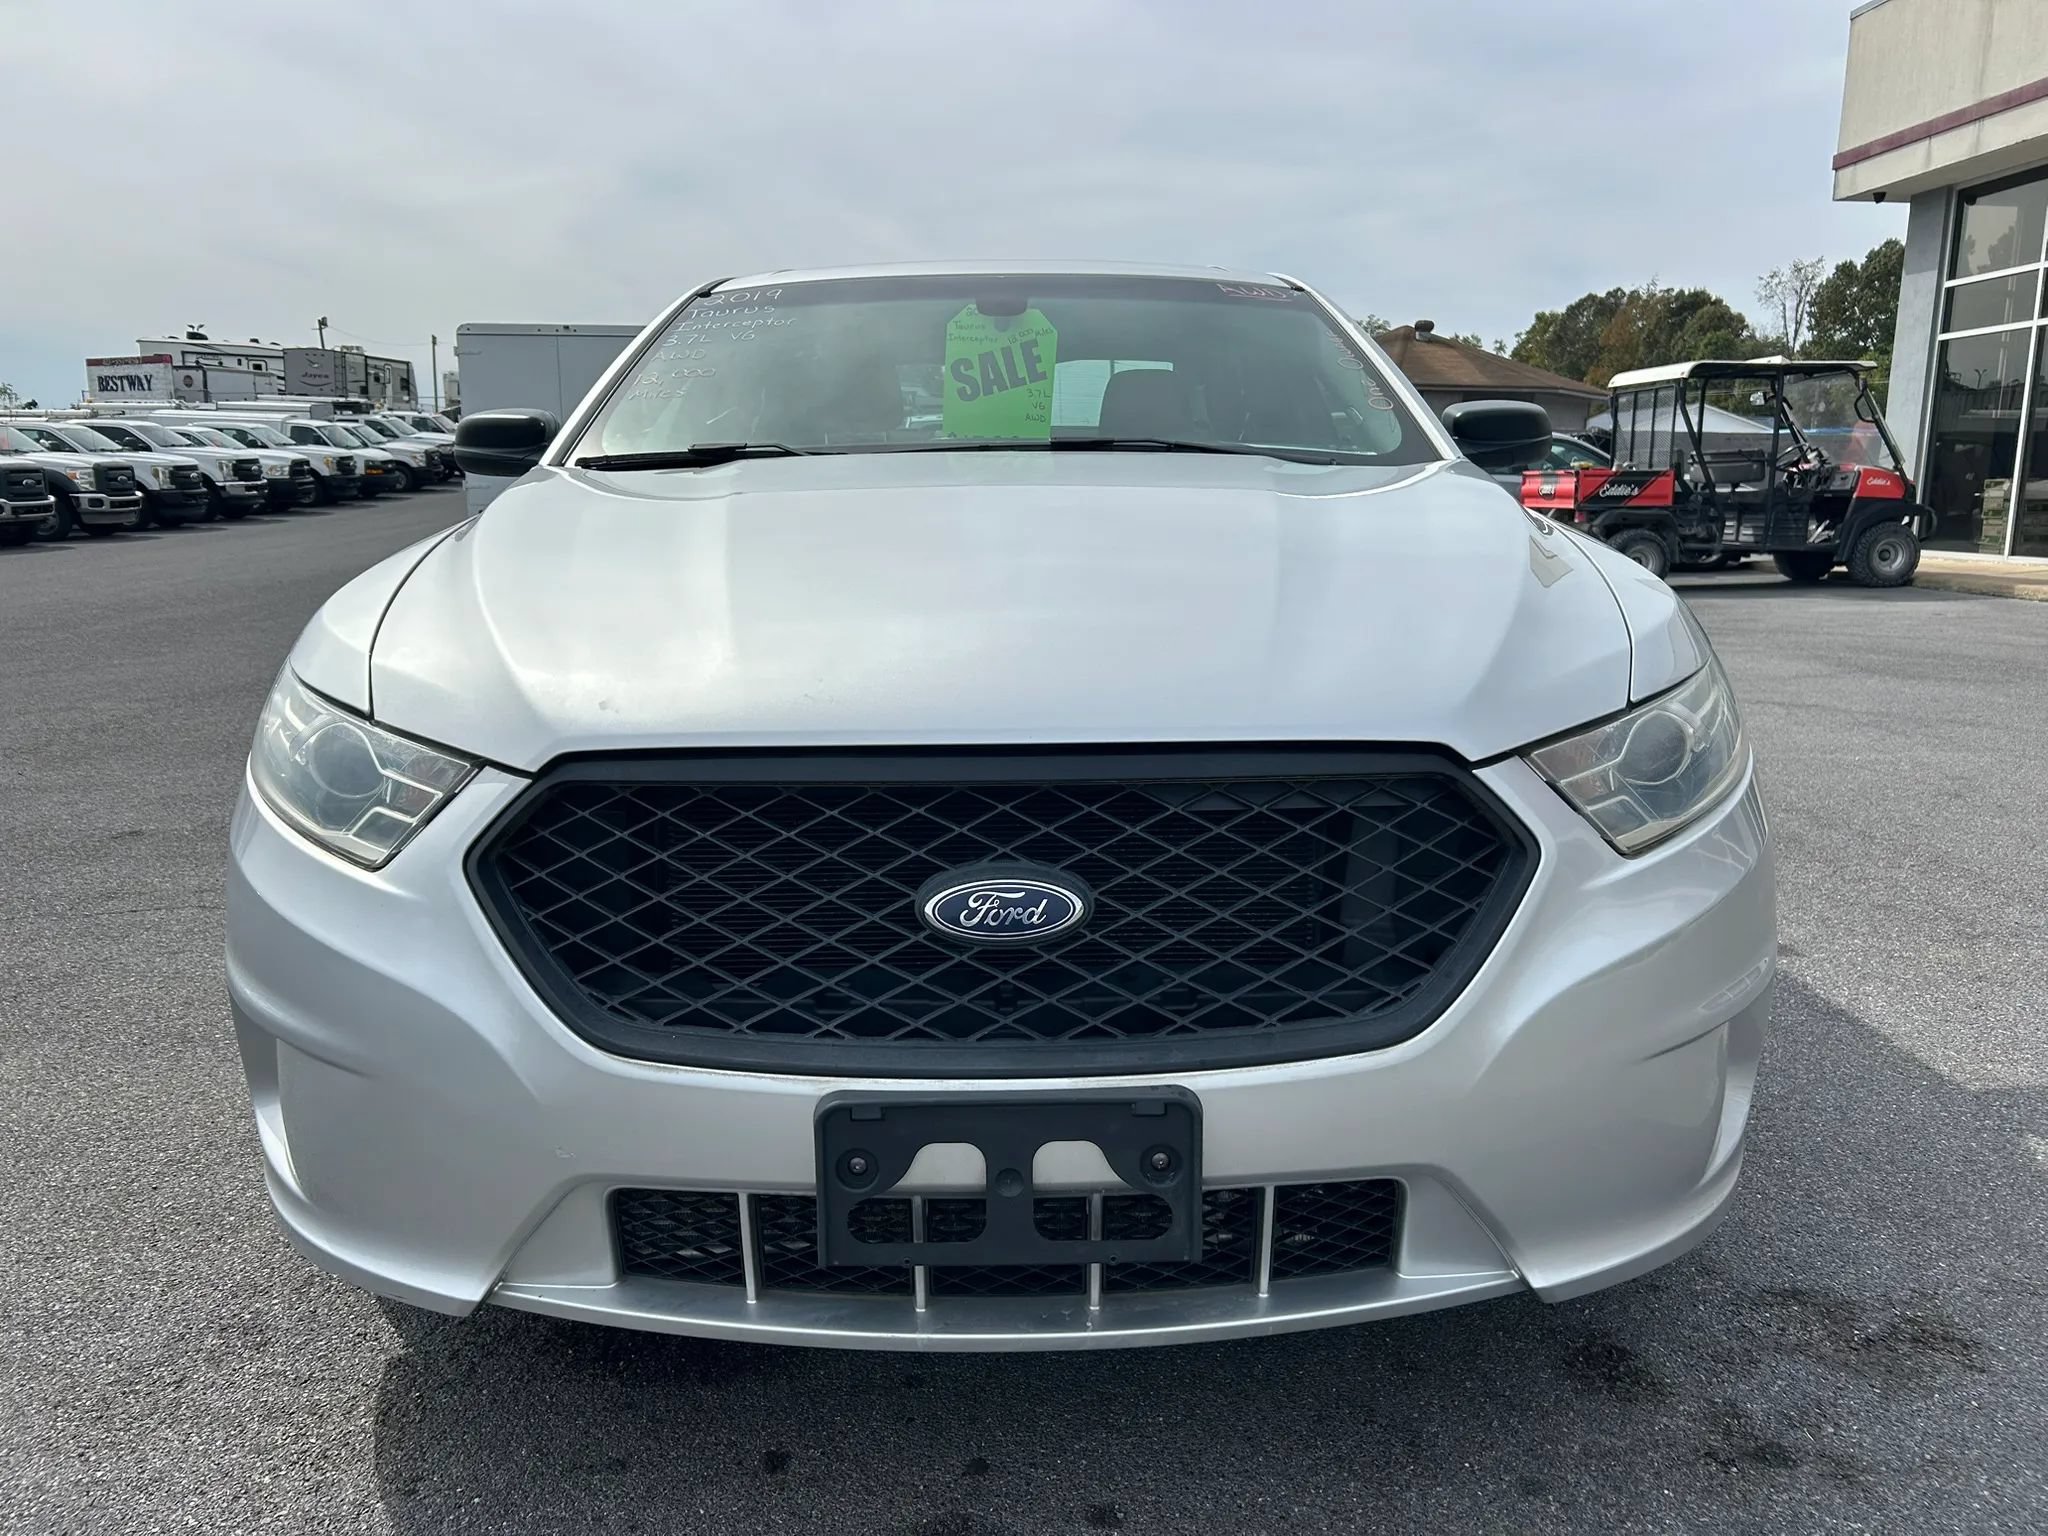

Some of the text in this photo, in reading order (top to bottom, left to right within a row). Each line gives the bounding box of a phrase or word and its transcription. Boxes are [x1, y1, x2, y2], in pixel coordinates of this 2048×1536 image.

[704, 289, 783, 306] 2019
[687, 305, 775, 319] Taurus
[672, 317, 797, 332] Interceptor
[663, 334, 713, 347] 3.7L
[651, 349, 706, 362] AWD
[950, 338, 1048, 401] SALE
[97, 374, 153, 393] BESTWAY
[1025, 413, 1047, 423] AWD
[1599, 483, 1640, 498] Eddie's
[959, 891, 1049, 928] Ford
